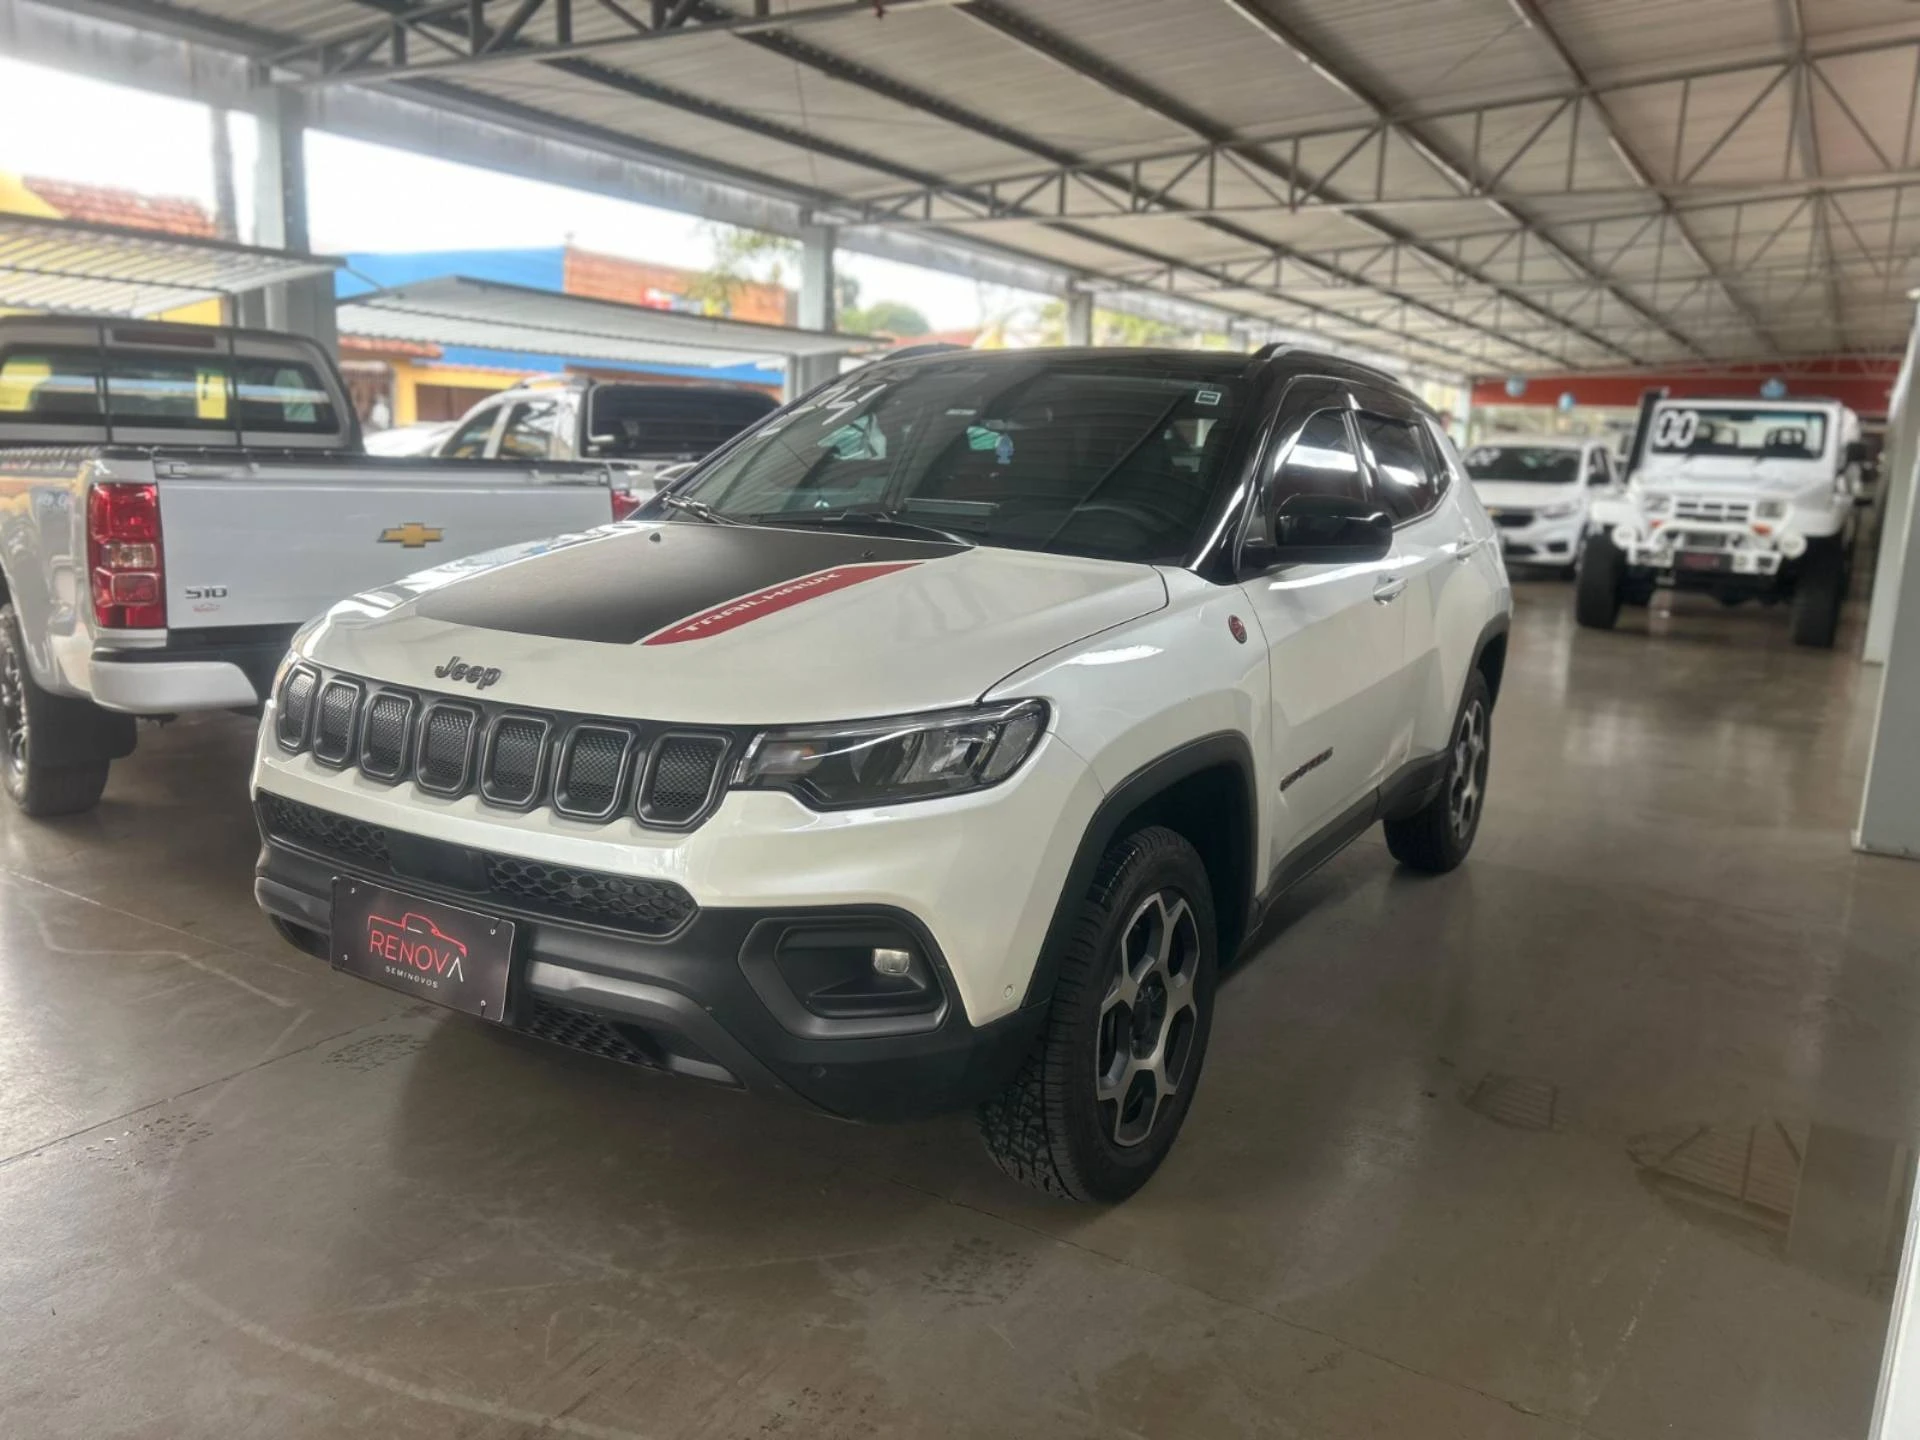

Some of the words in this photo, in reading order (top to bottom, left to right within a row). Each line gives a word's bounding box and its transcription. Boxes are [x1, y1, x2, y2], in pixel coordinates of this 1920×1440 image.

[184, 585, 228, 600] S10
[675, 572, 842, 634] TRAILHAWK
[434, 655, 502, 690] Jeep
[369, 929, 464, 983] RENOVA
[385, 965, 439, 989] SEMINOVOS
